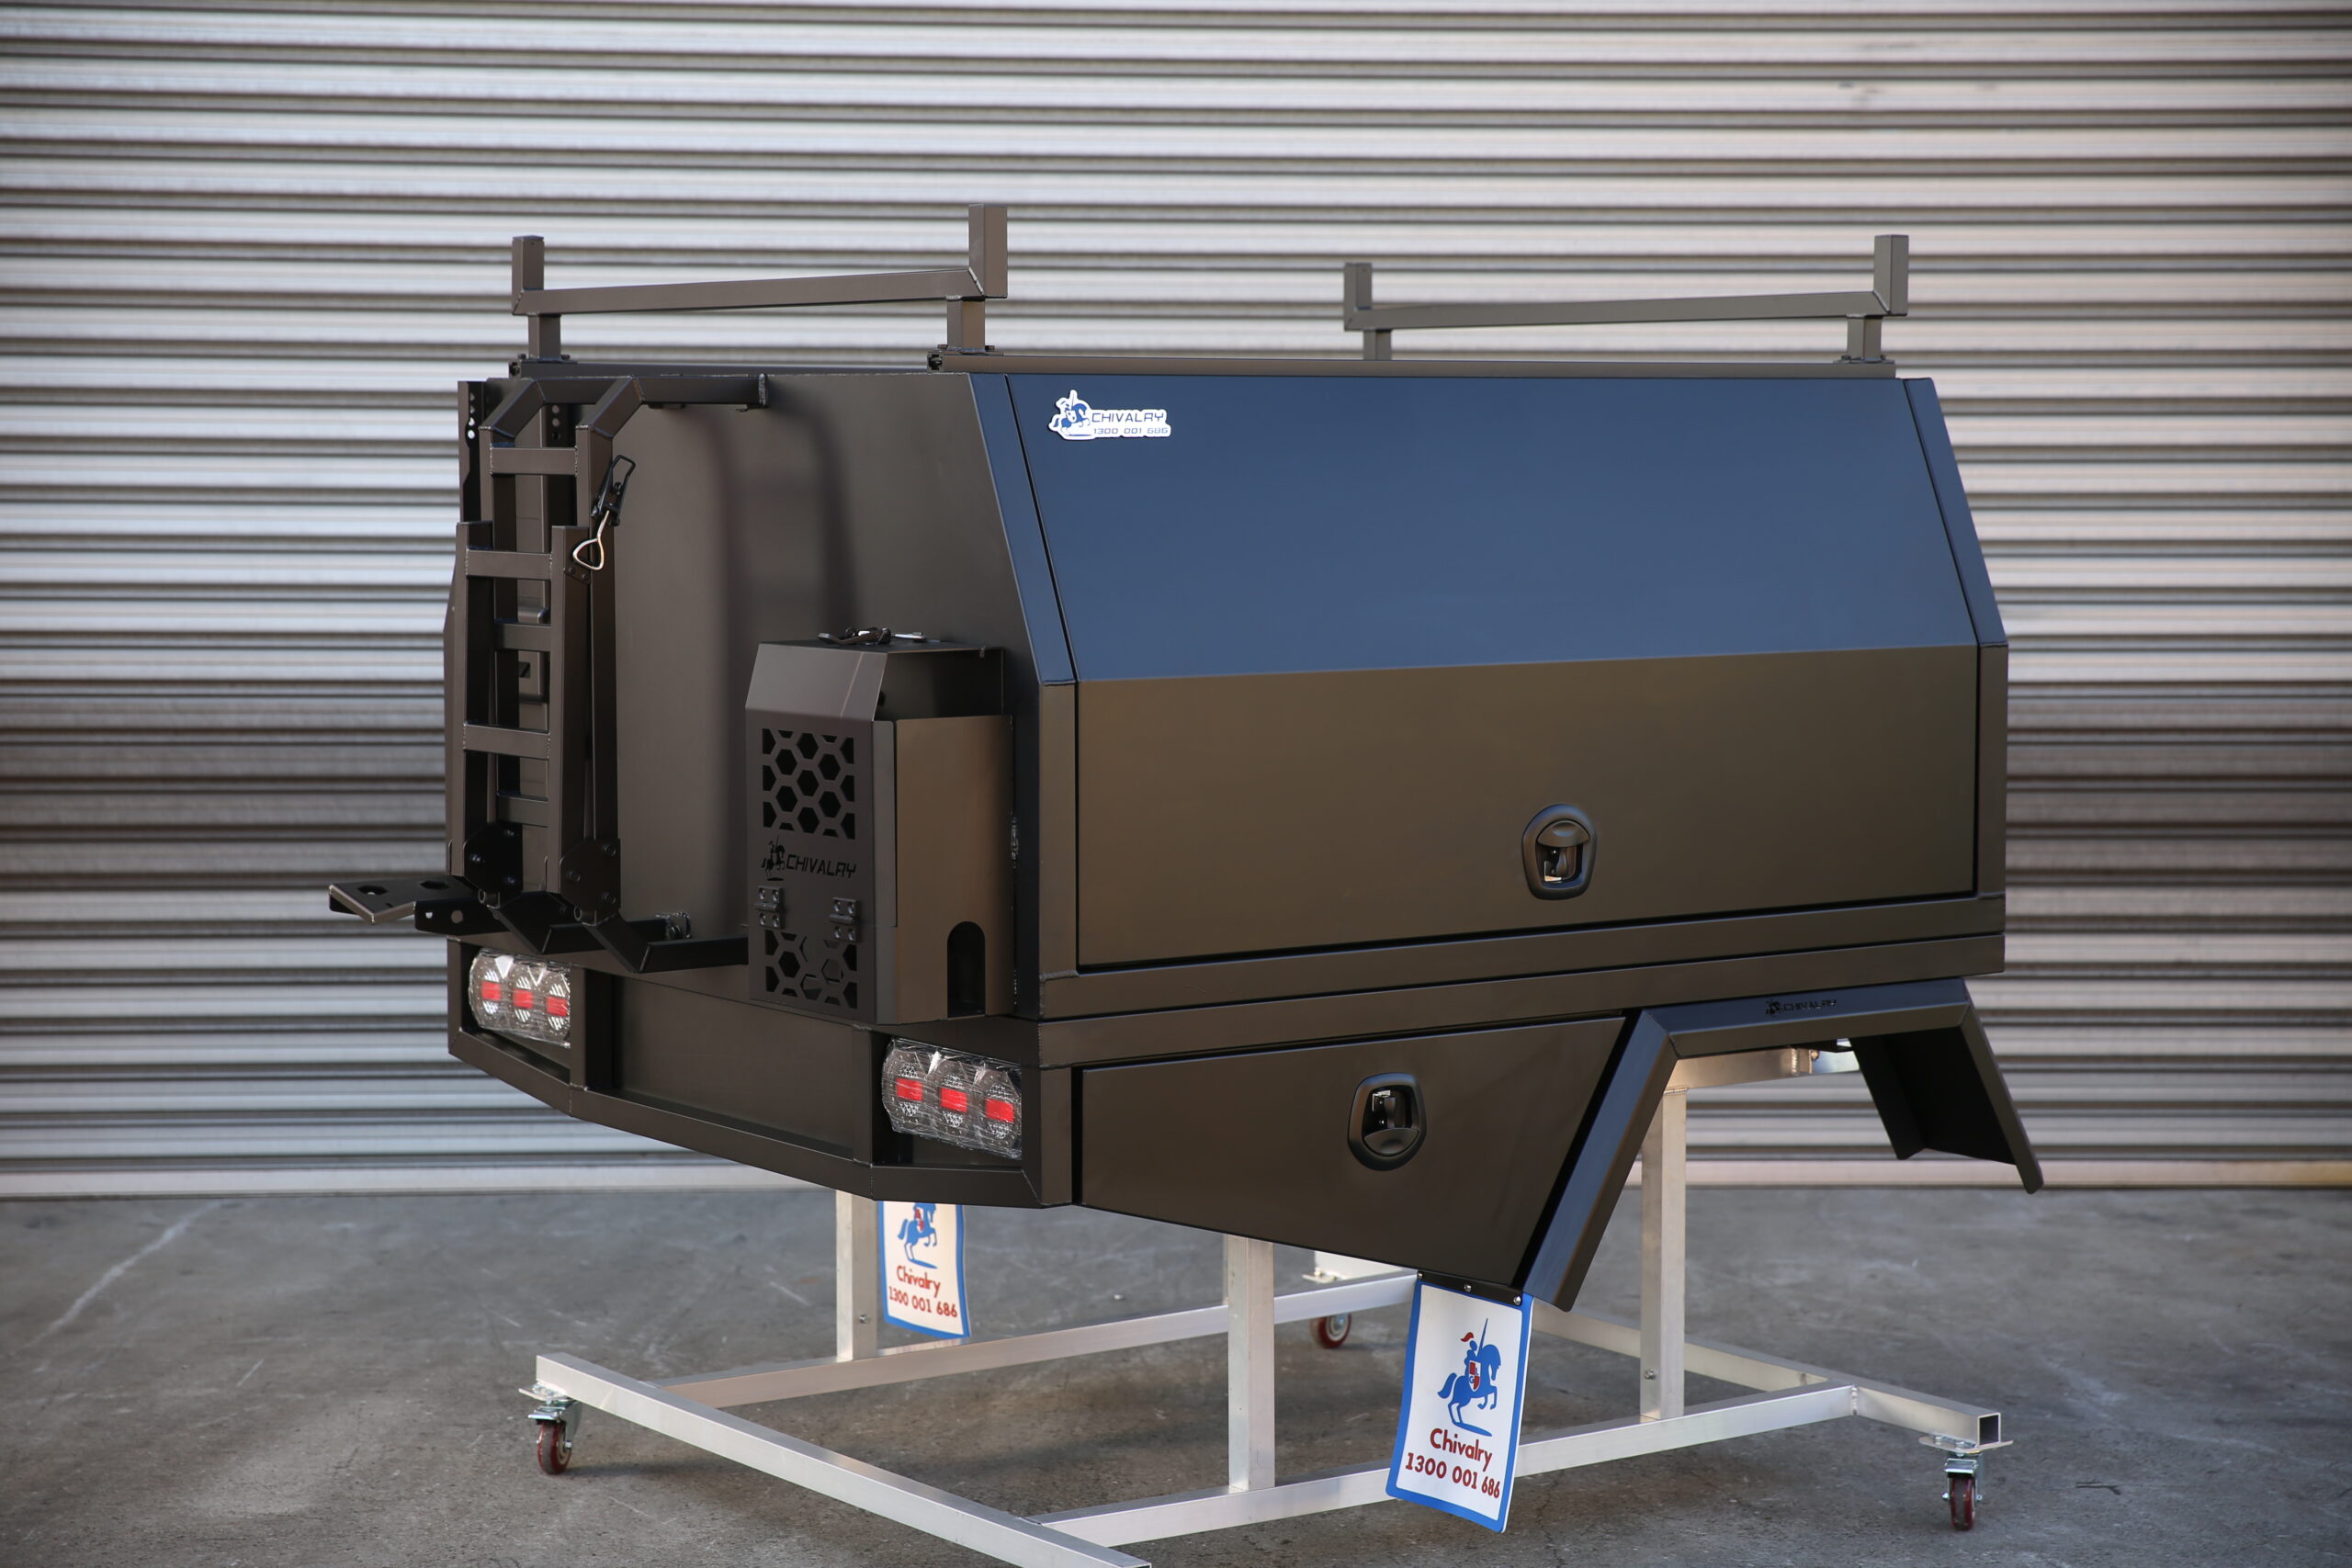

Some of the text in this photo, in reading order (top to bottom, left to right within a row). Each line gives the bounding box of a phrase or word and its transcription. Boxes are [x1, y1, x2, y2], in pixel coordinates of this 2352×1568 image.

[1091, 412, 1164, 423] CHIVALRY
[786, 853, 856, 879] CHIVALRY
[897, 1265, 941, 1298] Chivalry
[888, 1286, 957, 1318] 1300 001 686
[1430, 1427, 1493, 1472] Chivalry
[1405, 1452, 1500, 1499] 1300 001 686
